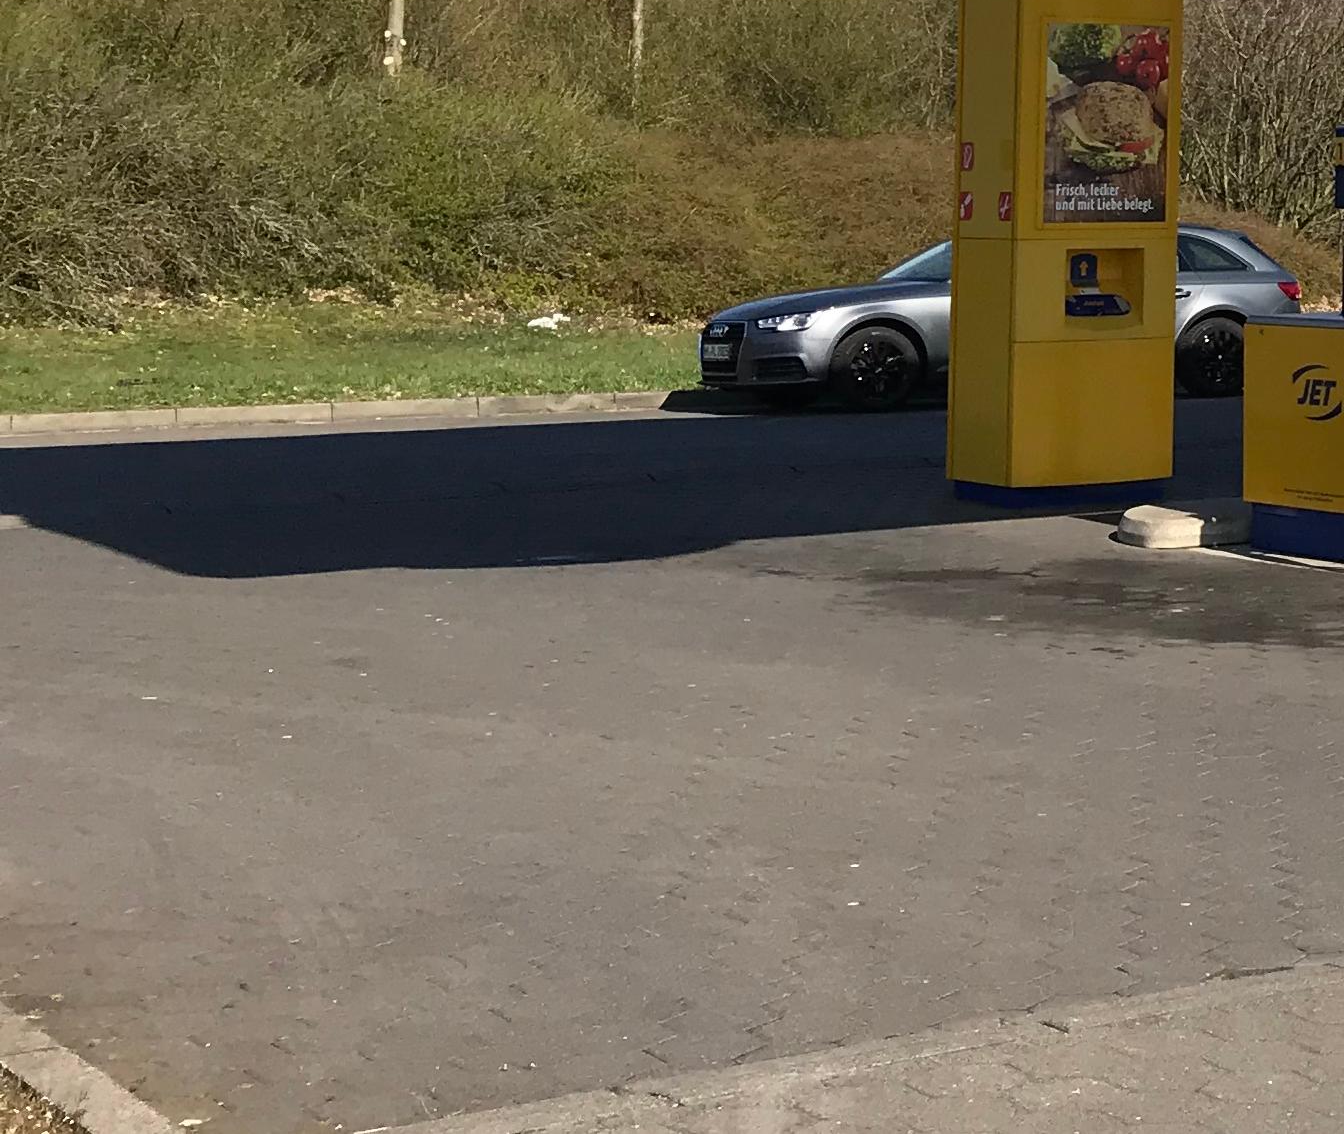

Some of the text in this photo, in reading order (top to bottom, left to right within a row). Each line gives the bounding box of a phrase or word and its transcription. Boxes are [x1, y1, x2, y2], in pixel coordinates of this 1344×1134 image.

[1055, 184, 1120, 198] Frisch, lecker
[1055, 198, 1154, 213] und mit Liebe belegt.
[1297, 379, 1337, 406] JET
